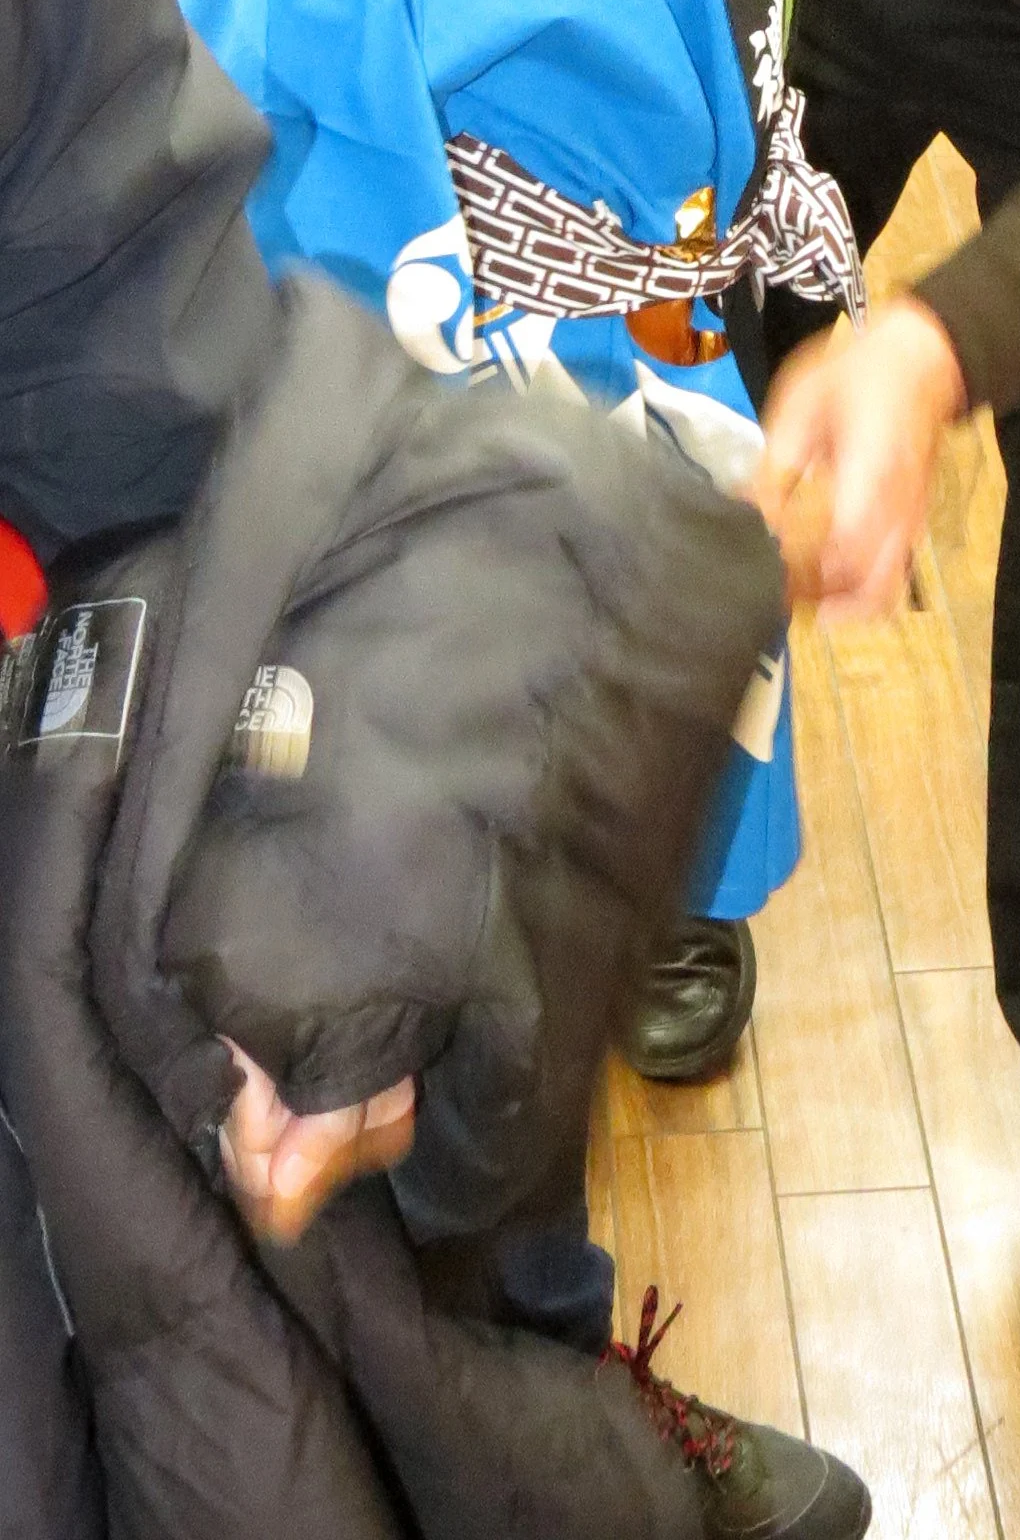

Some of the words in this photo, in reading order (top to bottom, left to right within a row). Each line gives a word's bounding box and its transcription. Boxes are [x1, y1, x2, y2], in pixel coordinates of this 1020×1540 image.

[48, 634, 74, 692] FACE
[64, 610, 94, 690] NORTH
[77, 642, 99, 689] THE
